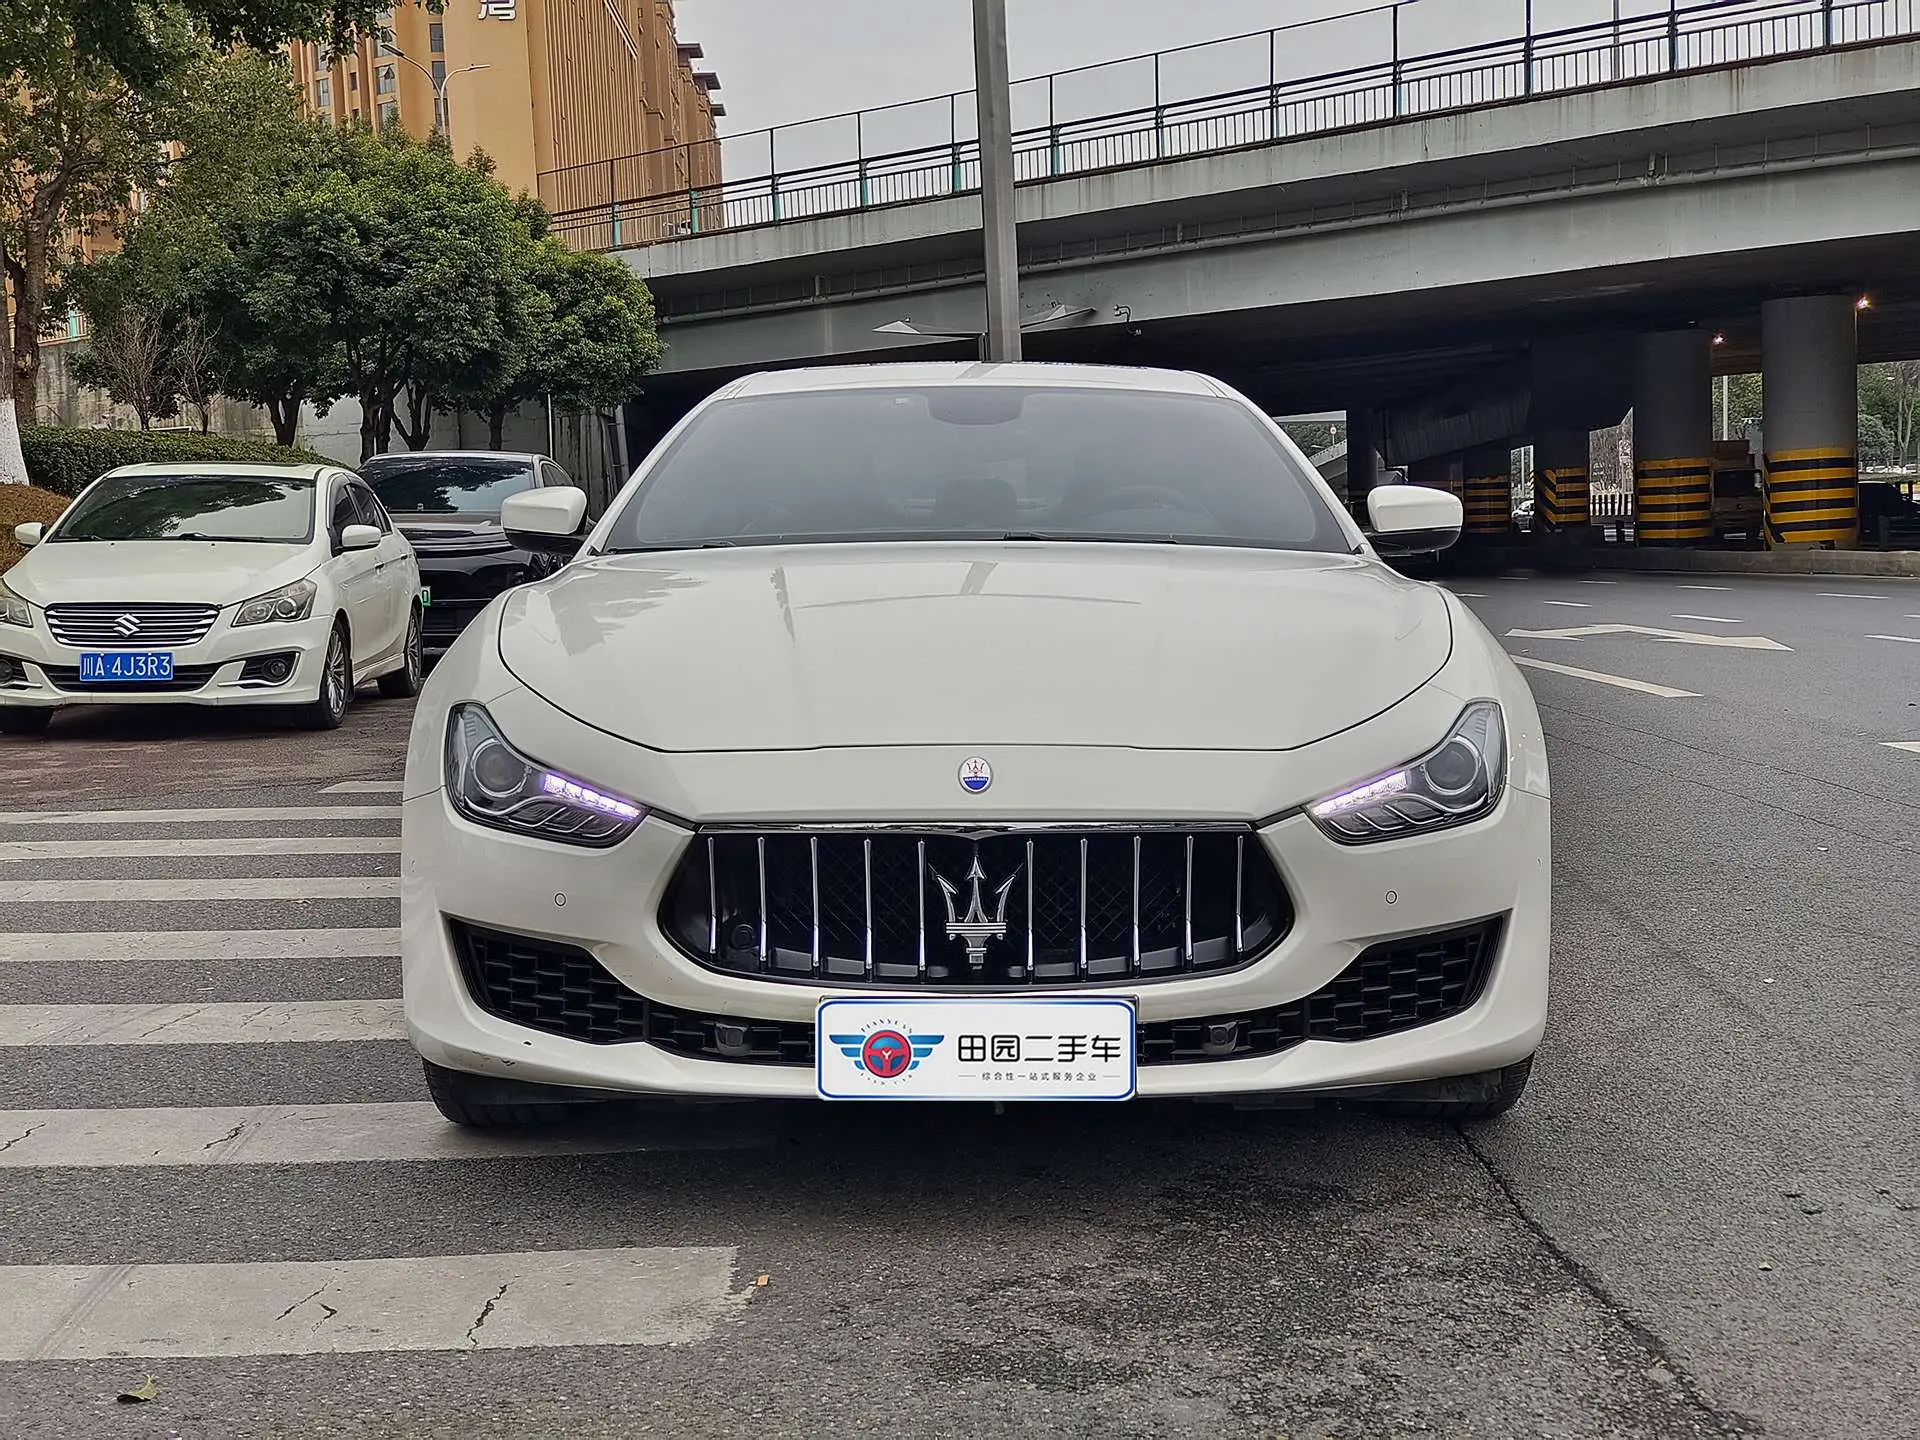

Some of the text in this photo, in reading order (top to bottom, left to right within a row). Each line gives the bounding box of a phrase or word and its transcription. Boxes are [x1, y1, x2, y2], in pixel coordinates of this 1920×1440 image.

[957, 1034, 1121, 1063] 田园二手车
[881, 1050, 892, 1060] Y
[981, 1071, 1097, 1082] 综合性一站式服务企业
